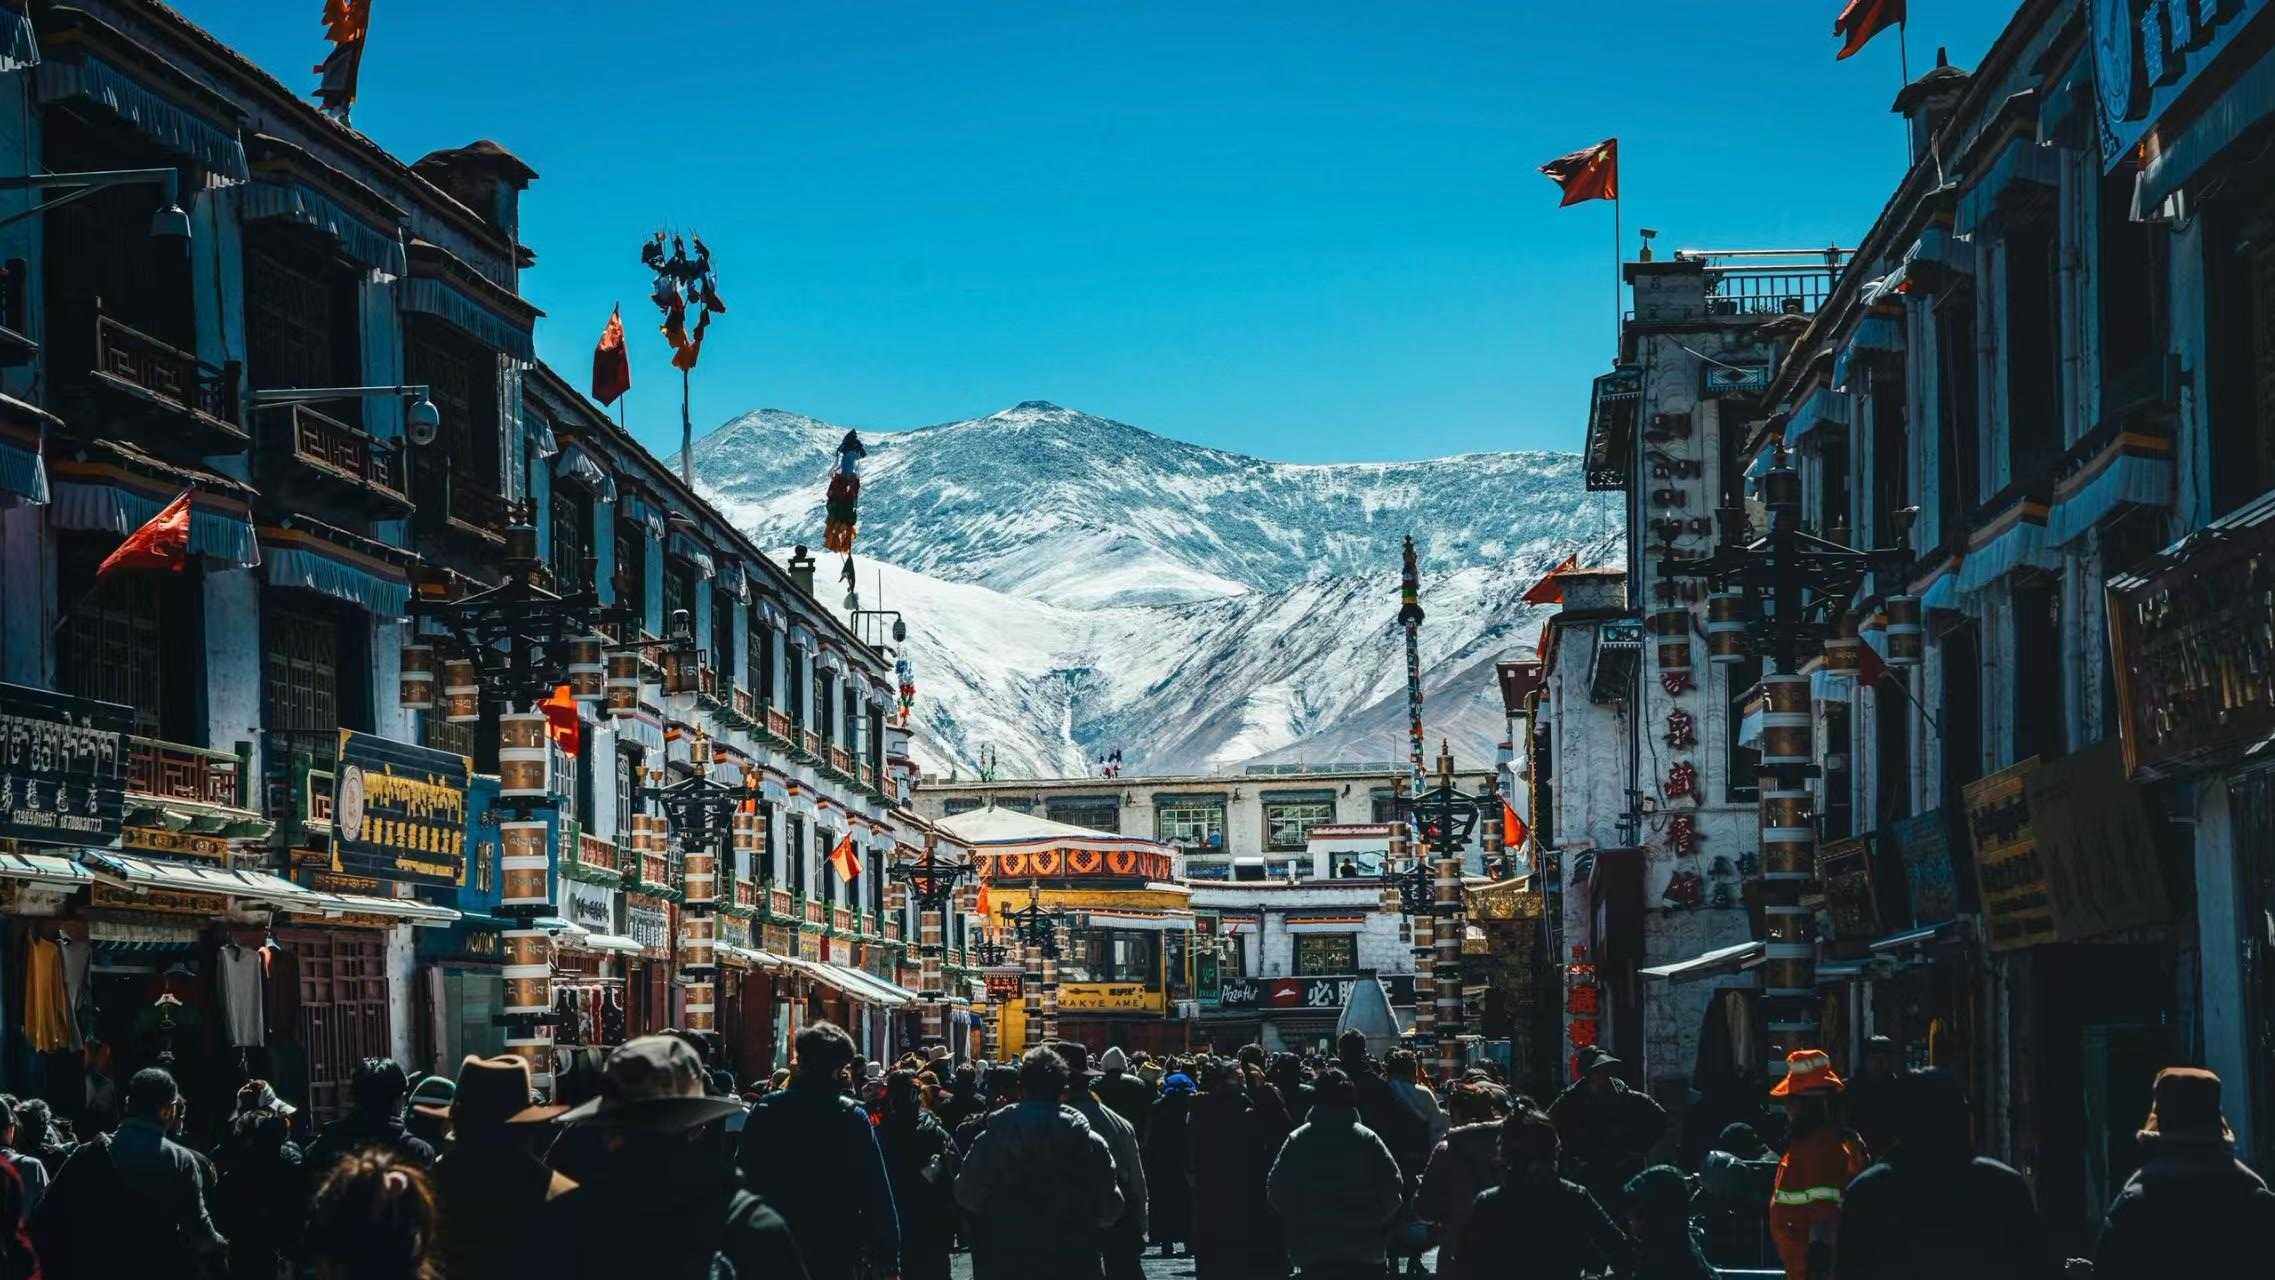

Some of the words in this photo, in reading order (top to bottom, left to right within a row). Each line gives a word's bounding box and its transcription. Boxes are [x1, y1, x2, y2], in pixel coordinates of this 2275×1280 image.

[1221, 984, 1242, 1003] Pizza
[1242, 984, 1259, 1001] Hut
[1058, 999, 1105, 1008] MAKYE
[1114, 999, 1138, 1008] AME
